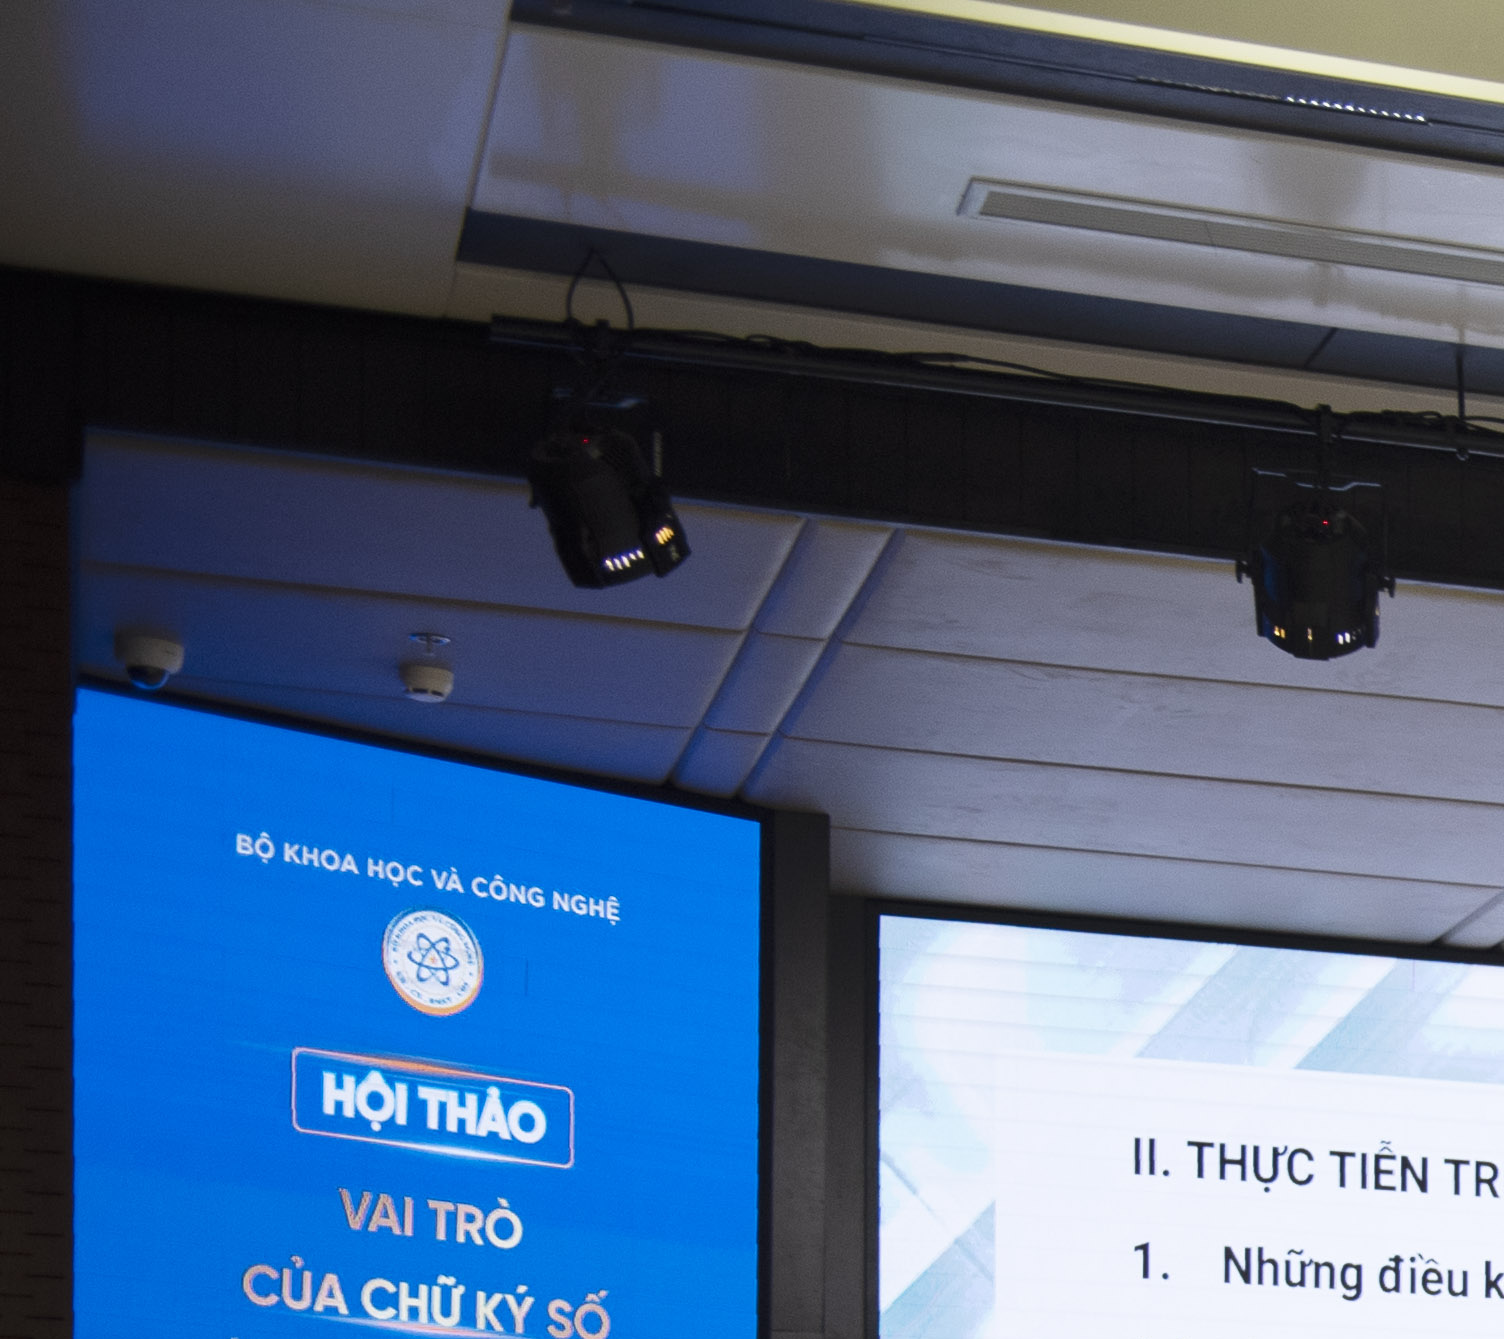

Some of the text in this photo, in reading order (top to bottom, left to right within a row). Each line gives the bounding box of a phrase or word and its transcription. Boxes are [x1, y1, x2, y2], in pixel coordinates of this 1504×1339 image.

[237, 832, 275, 863] BỘ
[284, 843, 359, 874] KHOA
[368, 858, 423, 887] HỌC
[472, 875, 545, 907] CÔNG
[553, 891, 620, 925] NGHỆ
[323, 1071, 546, 1143] HỘI THẢO
[1134, 1138, 1169, 1176] II.
[1187, 1141, 1314, 1193] THỰC
[1329, 1141, 1428, 1193] TIỄN
[339, 1188, 523, 1249] VAI TRÒ
[243, 1256, 349, 1315] CỦA
[358, 1275, 469, 1329] CHỮ
[473, 1285, 534, 1338] KÝ
[1134, 1242, 1169, 1280] 1.
[1224, 1246, 1362, 1301] Những
[1379, 1253, 1468, 1297] điều
